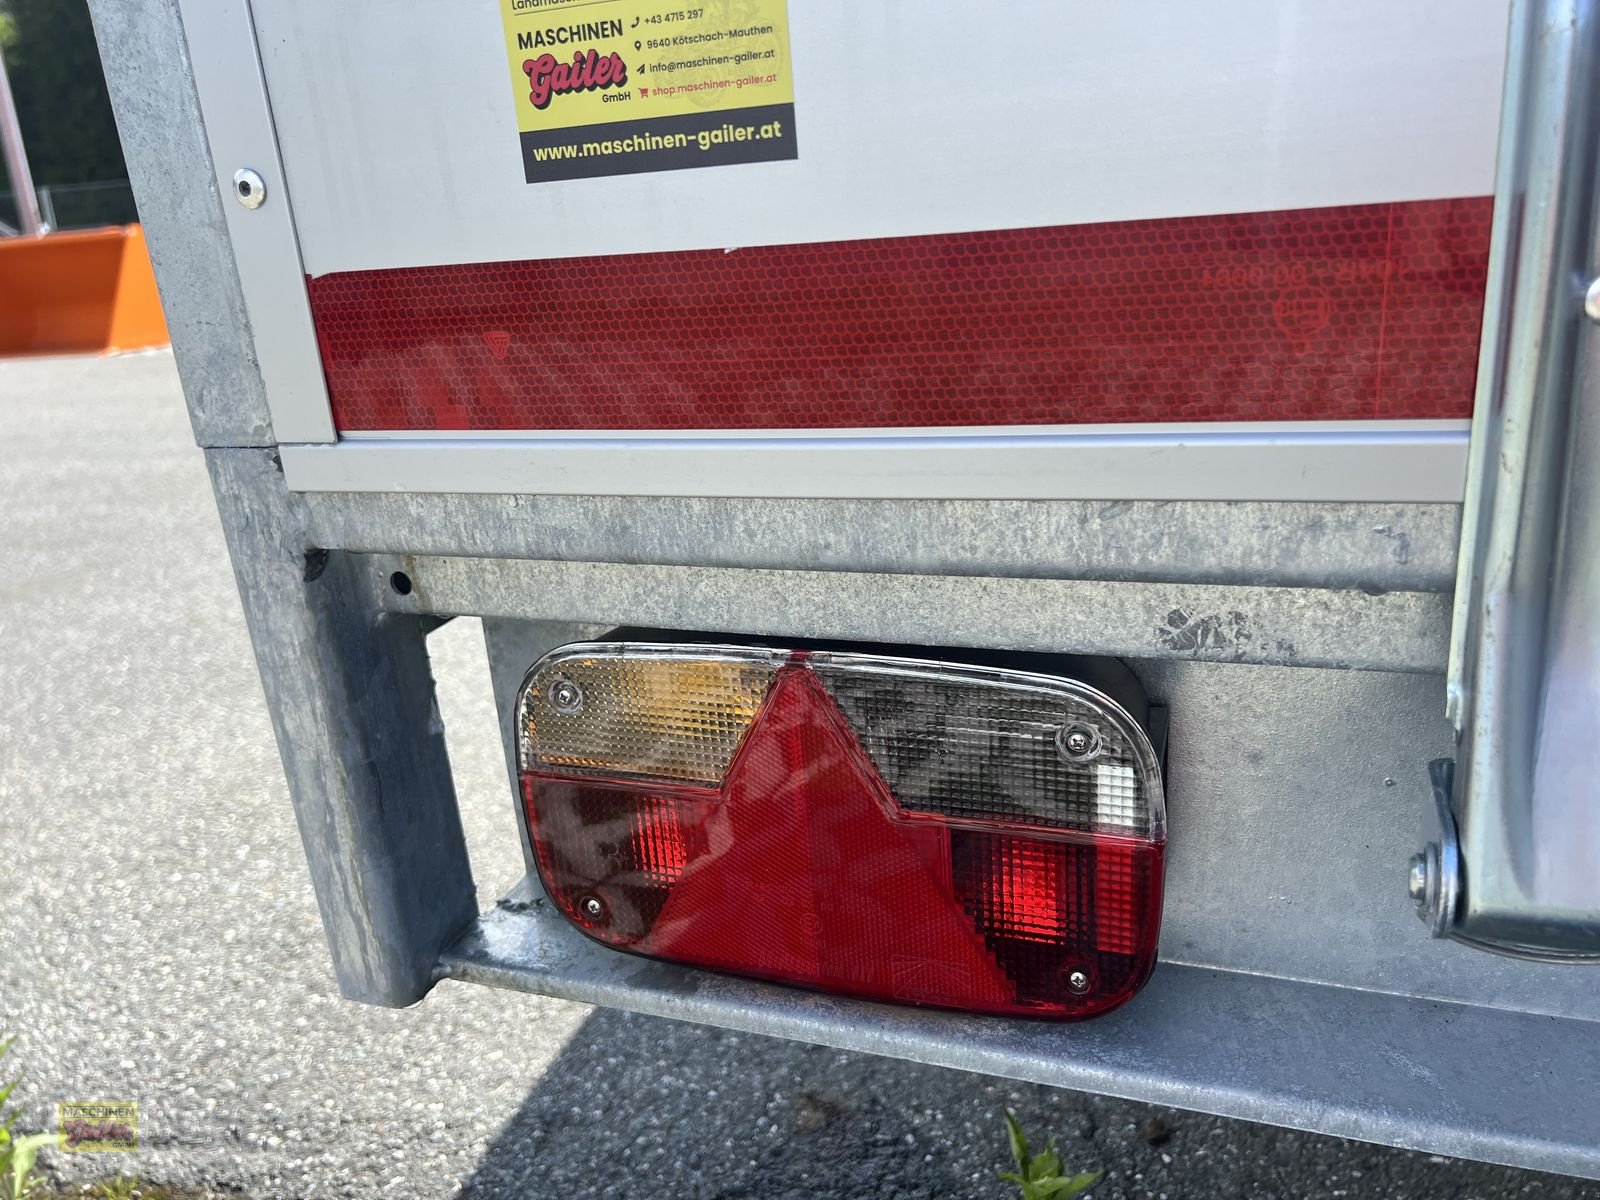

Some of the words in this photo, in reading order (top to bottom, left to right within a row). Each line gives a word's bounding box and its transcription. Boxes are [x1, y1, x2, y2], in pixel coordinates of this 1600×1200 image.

[645, 14, 662, 25] +43
[665, 11, 685, 22] 4715
[687, 8, 704, 20] 297
[517, 19, 624, 50] MASCHINEN
[647, 37, 671, 49] 9640
[672, 25, 773, 46] Kötschach-Mauthen
[649, 49, 775, 73] info@maschinen-gailer.at
[522, 48, 628, 110] Gailer
[652, 73, 776, 97] shop.maschinen-gailer.at
[602, 91, 631, 103] GmbH
[533, 120, 782, 162] www.maschinen-gailer.at
